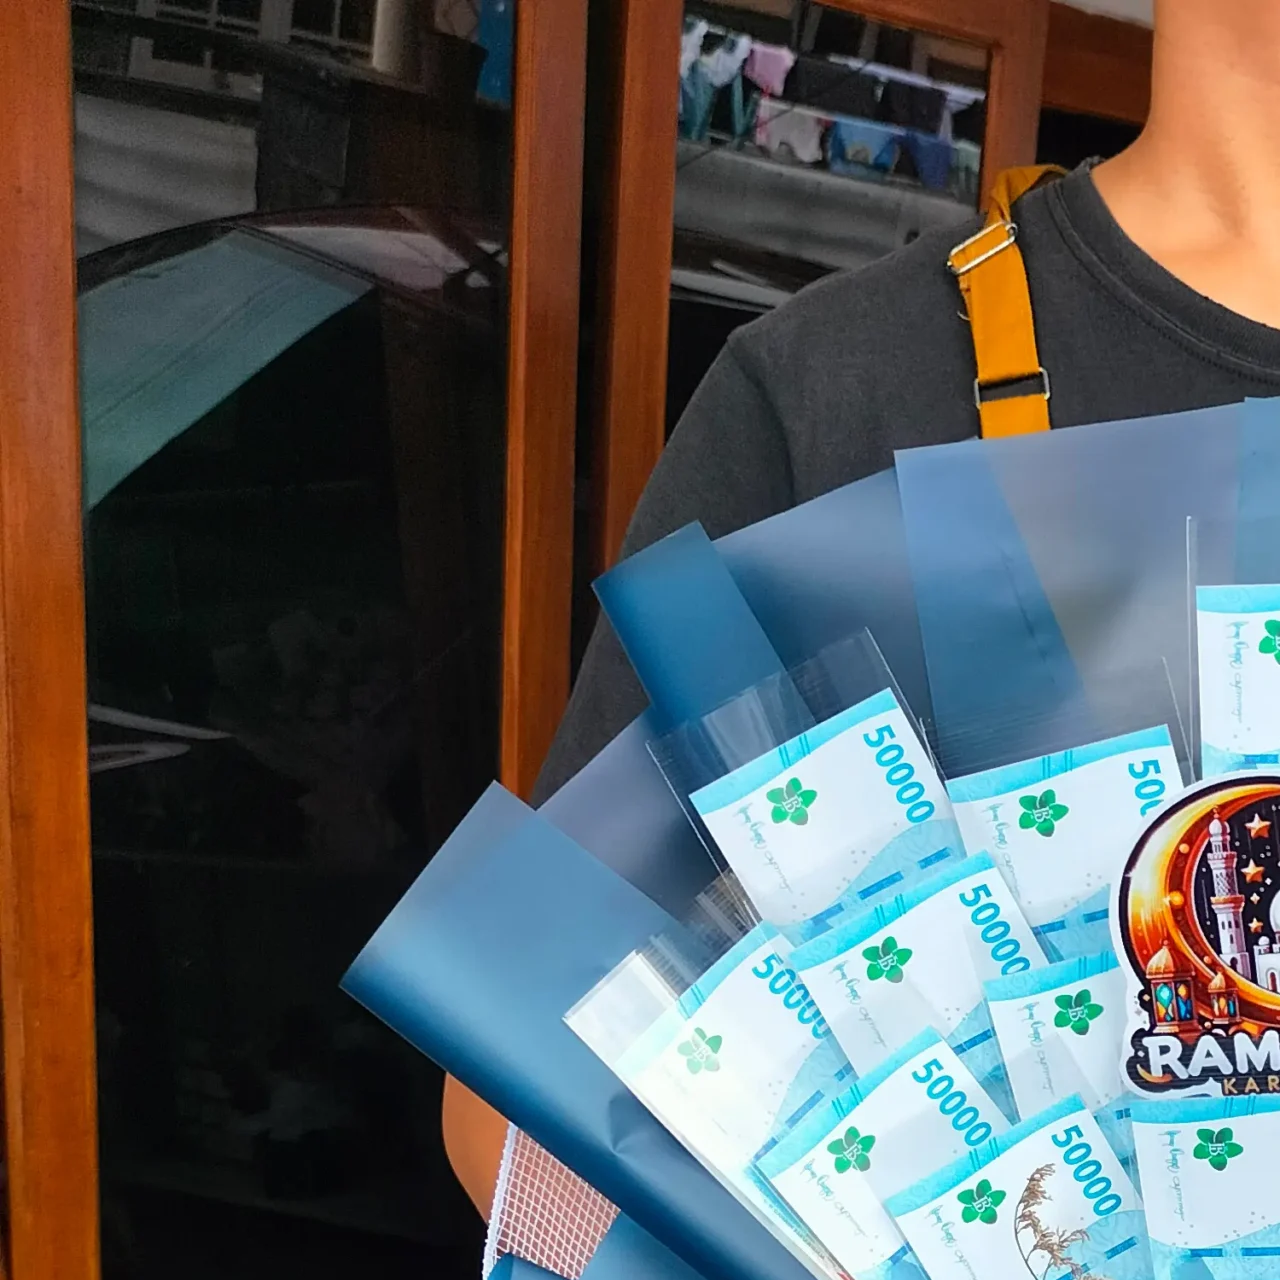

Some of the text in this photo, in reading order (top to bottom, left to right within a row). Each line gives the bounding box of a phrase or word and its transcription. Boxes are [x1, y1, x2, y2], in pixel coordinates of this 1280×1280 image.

[862, 723, 935, 824] 50000
[959, 883, 1030, 977] 50000
[911, 1059, 991, 1146] 50000
[1051, 1125, 1121, 1216] 50000
